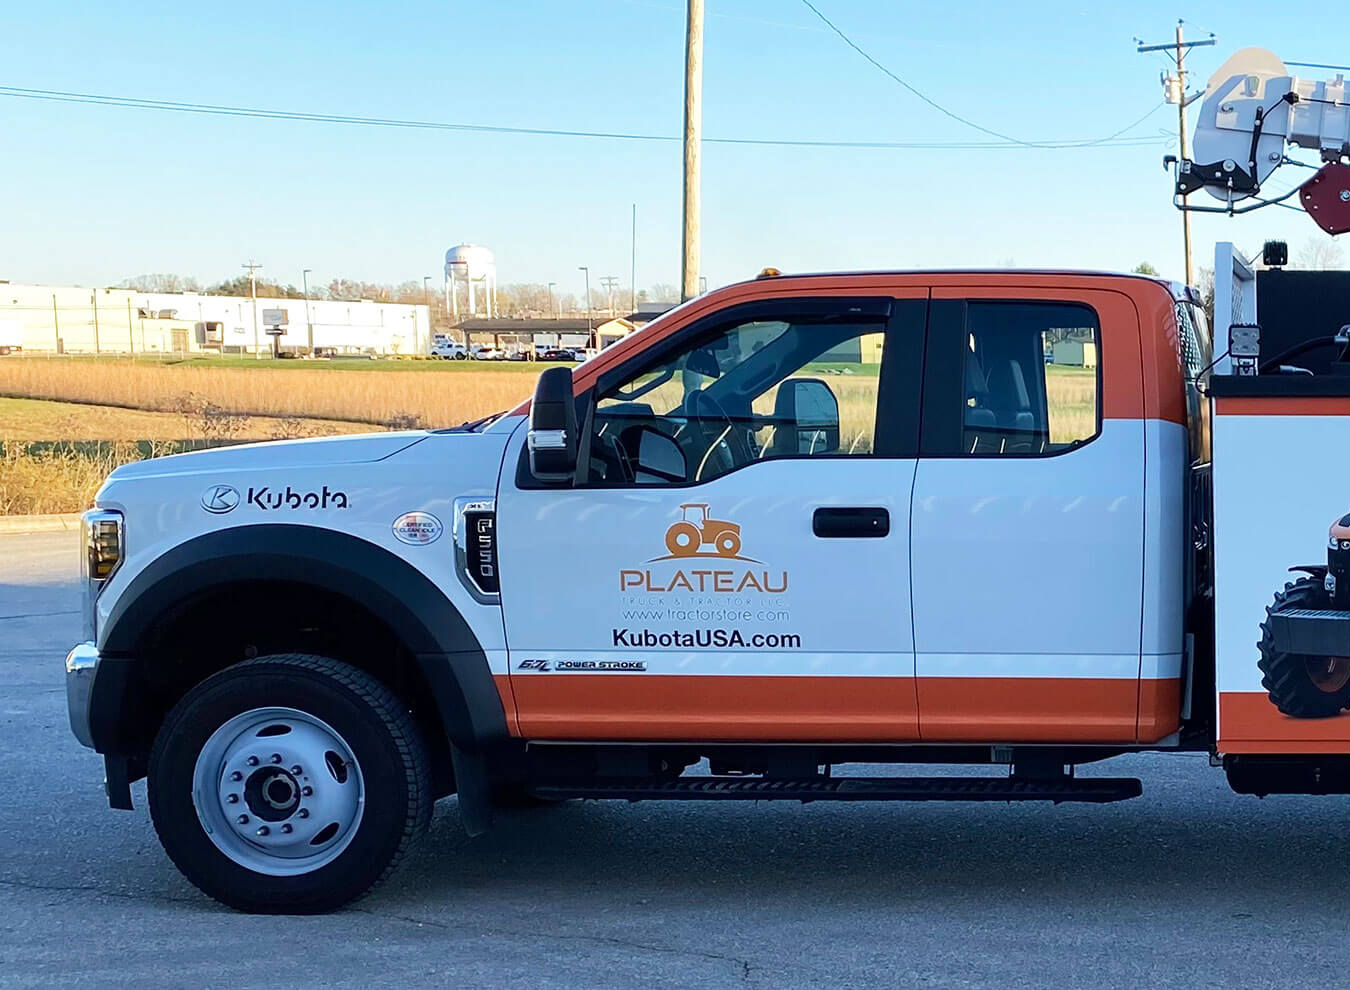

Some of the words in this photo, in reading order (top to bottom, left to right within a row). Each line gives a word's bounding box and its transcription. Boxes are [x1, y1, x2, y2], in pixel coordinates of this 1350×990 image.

[247, 486, 348, 510] Kubota
[620, 570, 788, 593] PLATEAU
[622, 608, 790, 621] wwwtractorstorecom
[612, 628, 802, 647] KubotaUSA.com
